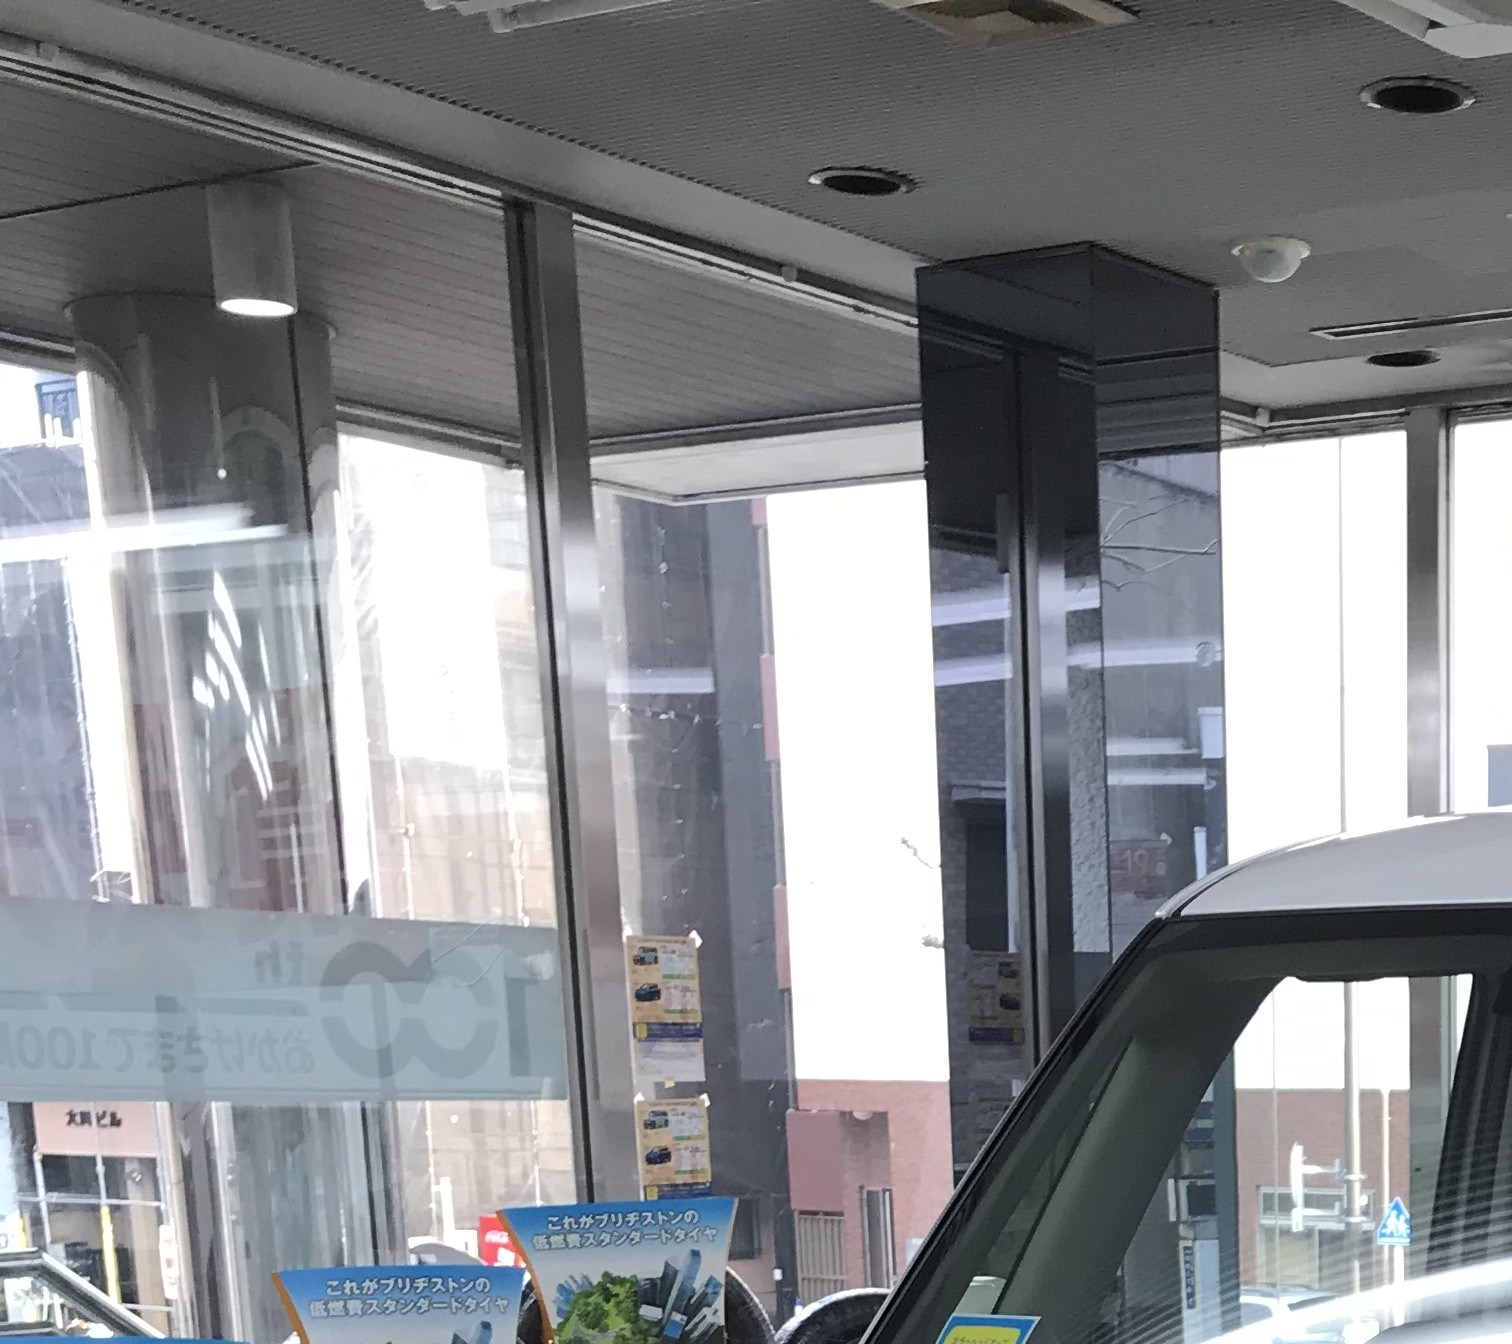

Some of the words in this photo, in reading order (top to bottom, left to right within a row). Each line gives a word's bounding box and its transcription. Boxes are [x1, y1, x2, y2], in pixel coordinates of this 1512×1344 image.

[532, 1227, 719, 1251] 低燃費スタンダードタイヤ
[309, 1298, 511, 1318] 低燃費スタンダードタイヤ
